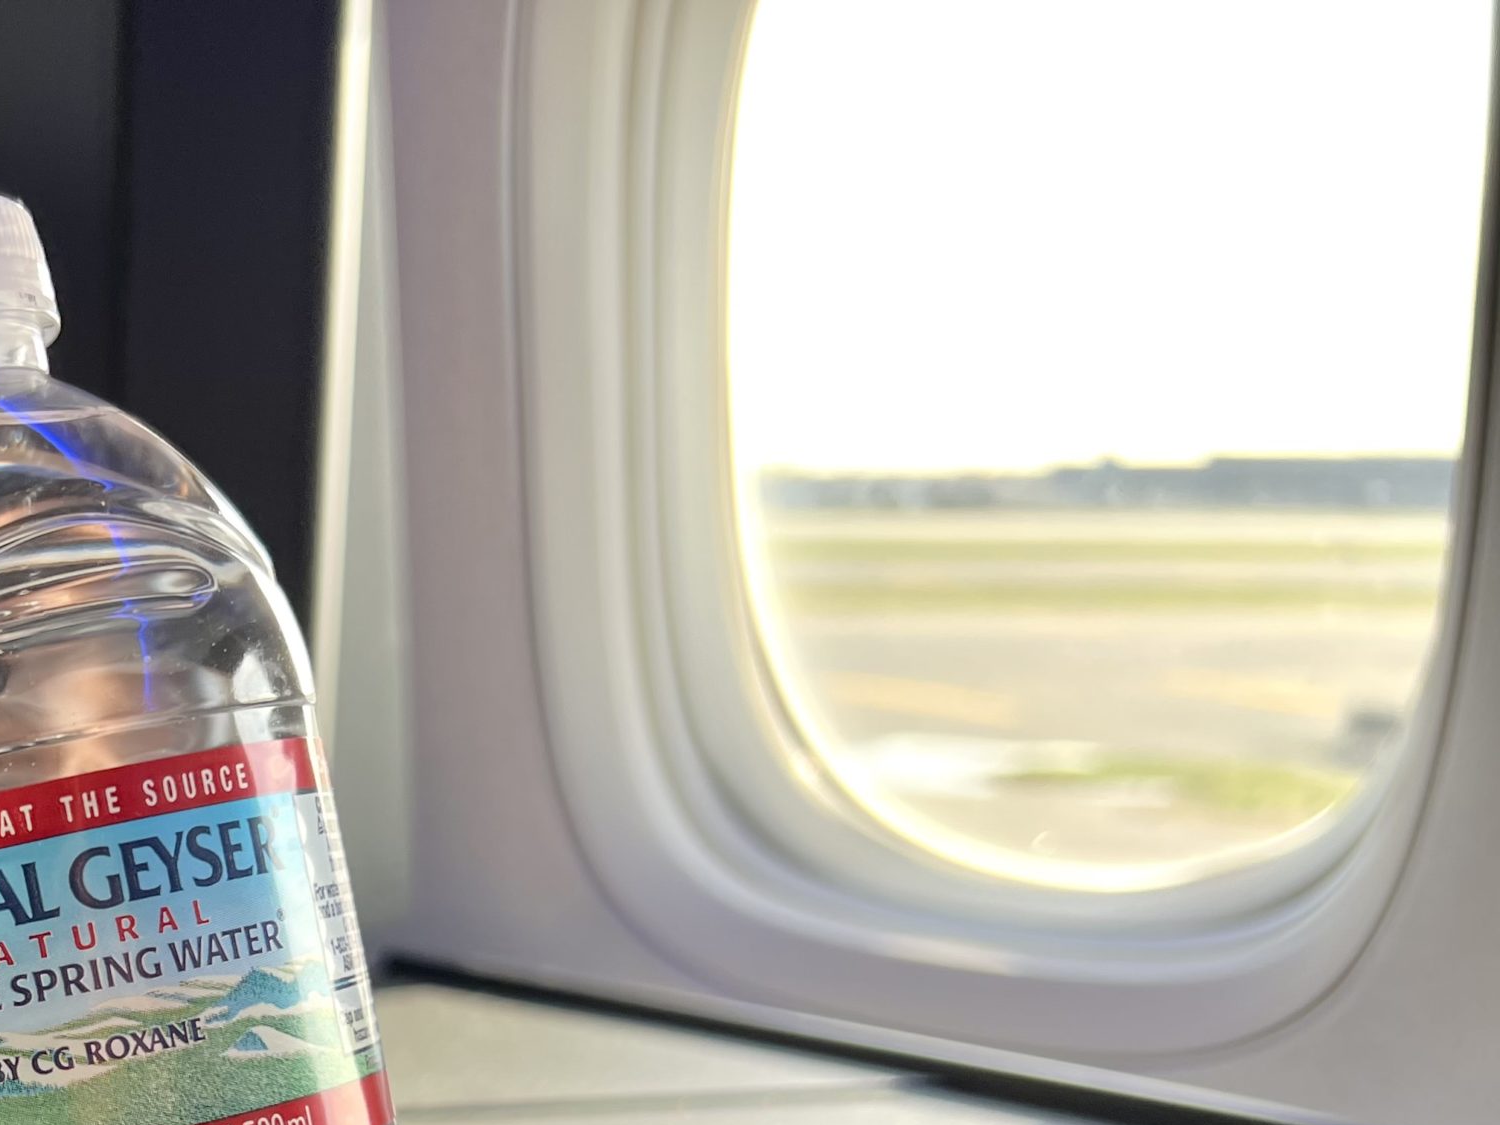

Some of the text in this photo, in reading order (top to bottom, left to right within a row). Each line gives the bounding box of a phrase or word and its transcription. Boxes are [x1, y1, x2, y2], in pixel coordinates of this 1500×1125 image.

[0, 804, 34, 838] AT
[59, 785, 121, 823] THE
[142, 762, 249, 807] SOURCE
[68, 814, 286, 910] GEYSER
[10, 946, 163, 1007] SPRING
[168, 919, 284, 973] WATER
[31, 1045, 75, 1075] CG
[84, 1017, 207, 1065] ROXANE
